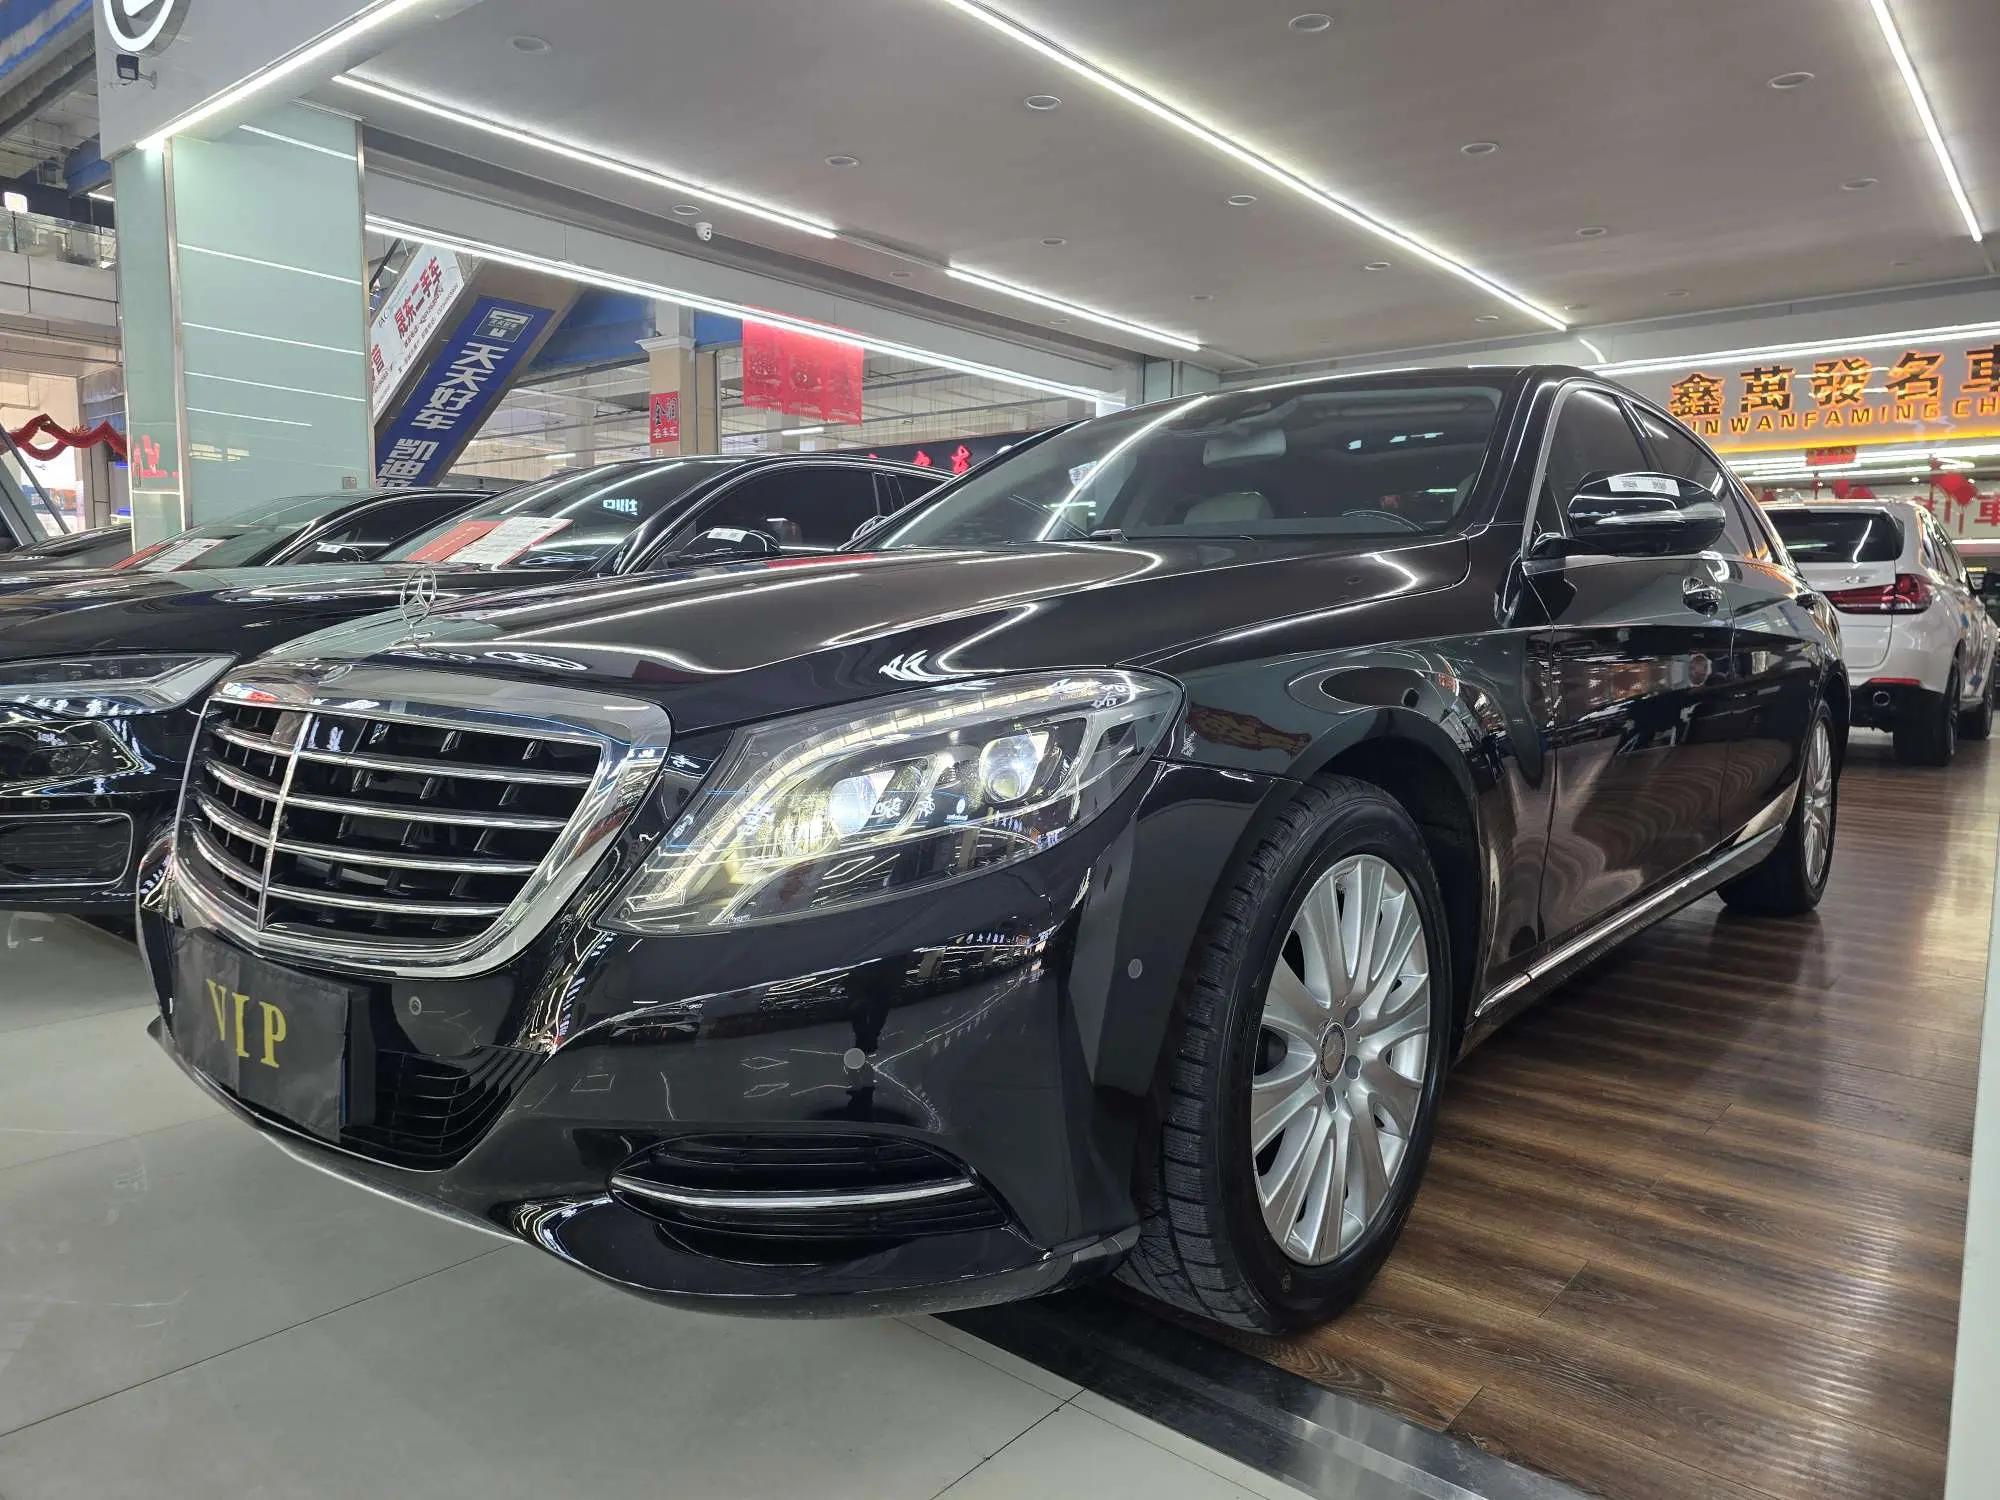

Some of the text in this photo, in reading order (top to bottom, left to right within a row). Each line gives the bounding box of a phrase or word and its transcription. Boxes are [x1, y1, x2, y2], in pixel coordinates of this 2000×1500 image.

[409, 341, 510, 430] 天天好车
[1729, 401, 1940, 434] WANFAMING
[206, 978, 287, 1068] VIP
